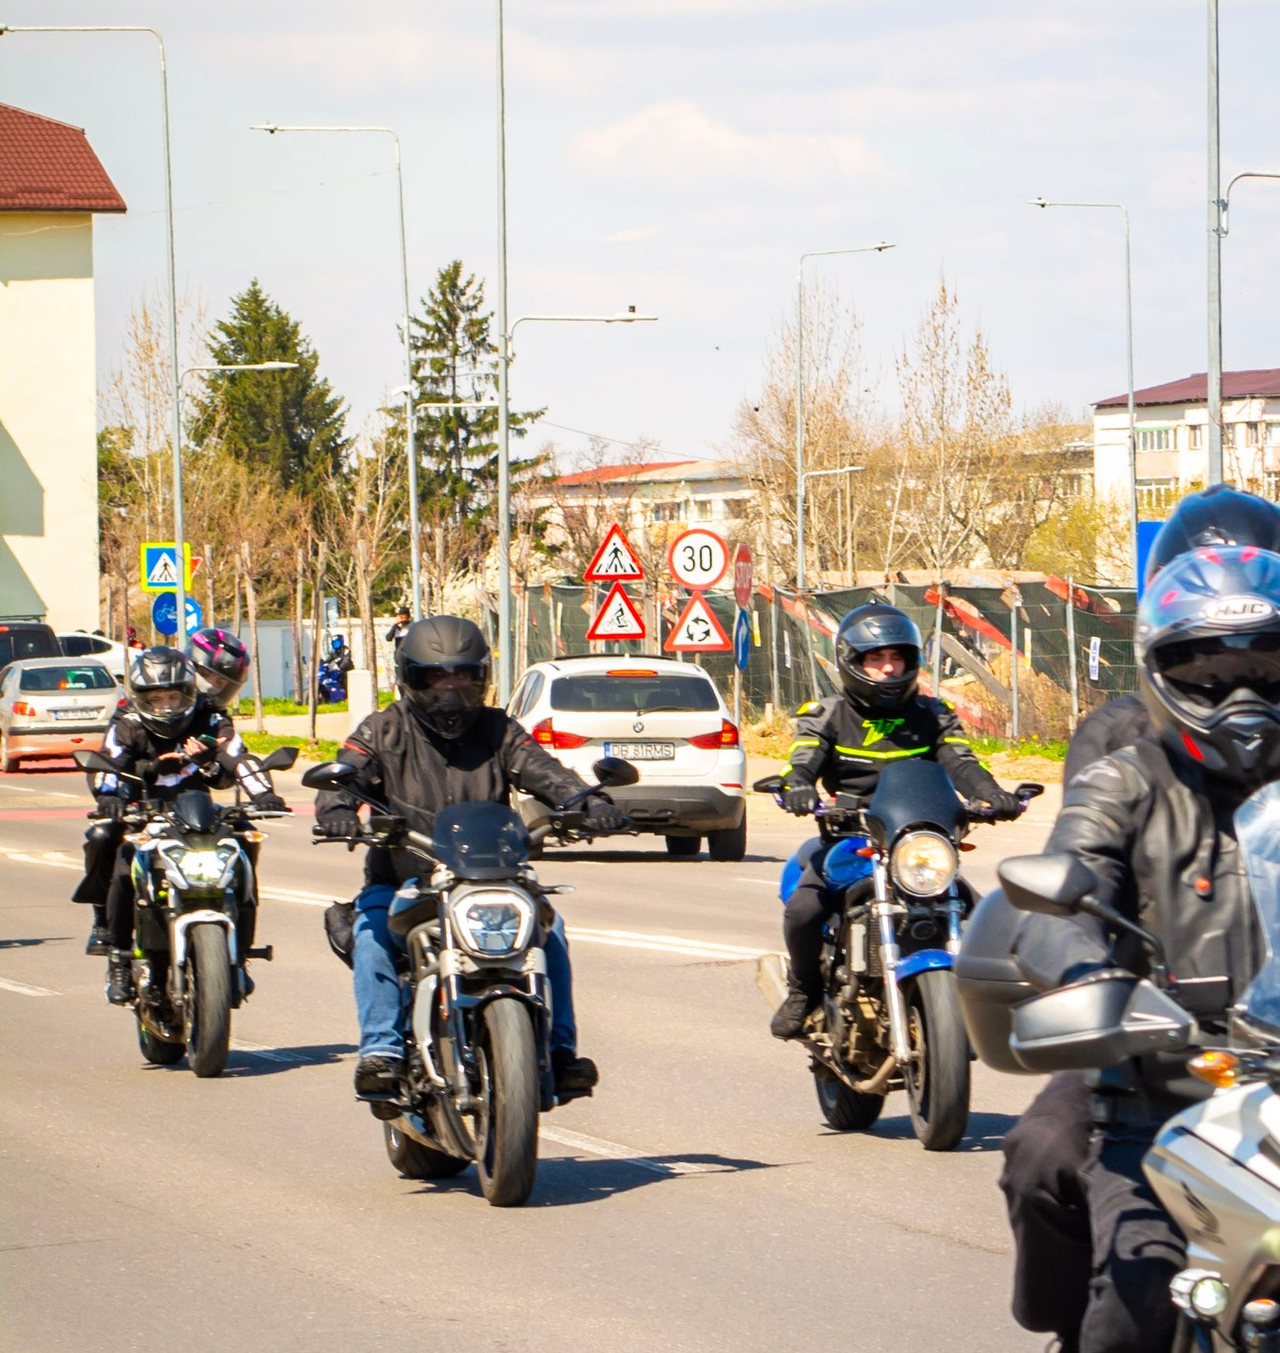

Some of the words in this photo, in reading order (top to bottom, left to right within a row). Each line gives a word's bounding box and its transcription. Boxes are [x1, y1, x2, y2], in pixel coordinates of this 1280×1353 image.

[682, 544, 713, 572] 30
[1214, 603, 1264, 618] HJC
[612, 744, 629, 756] DB
